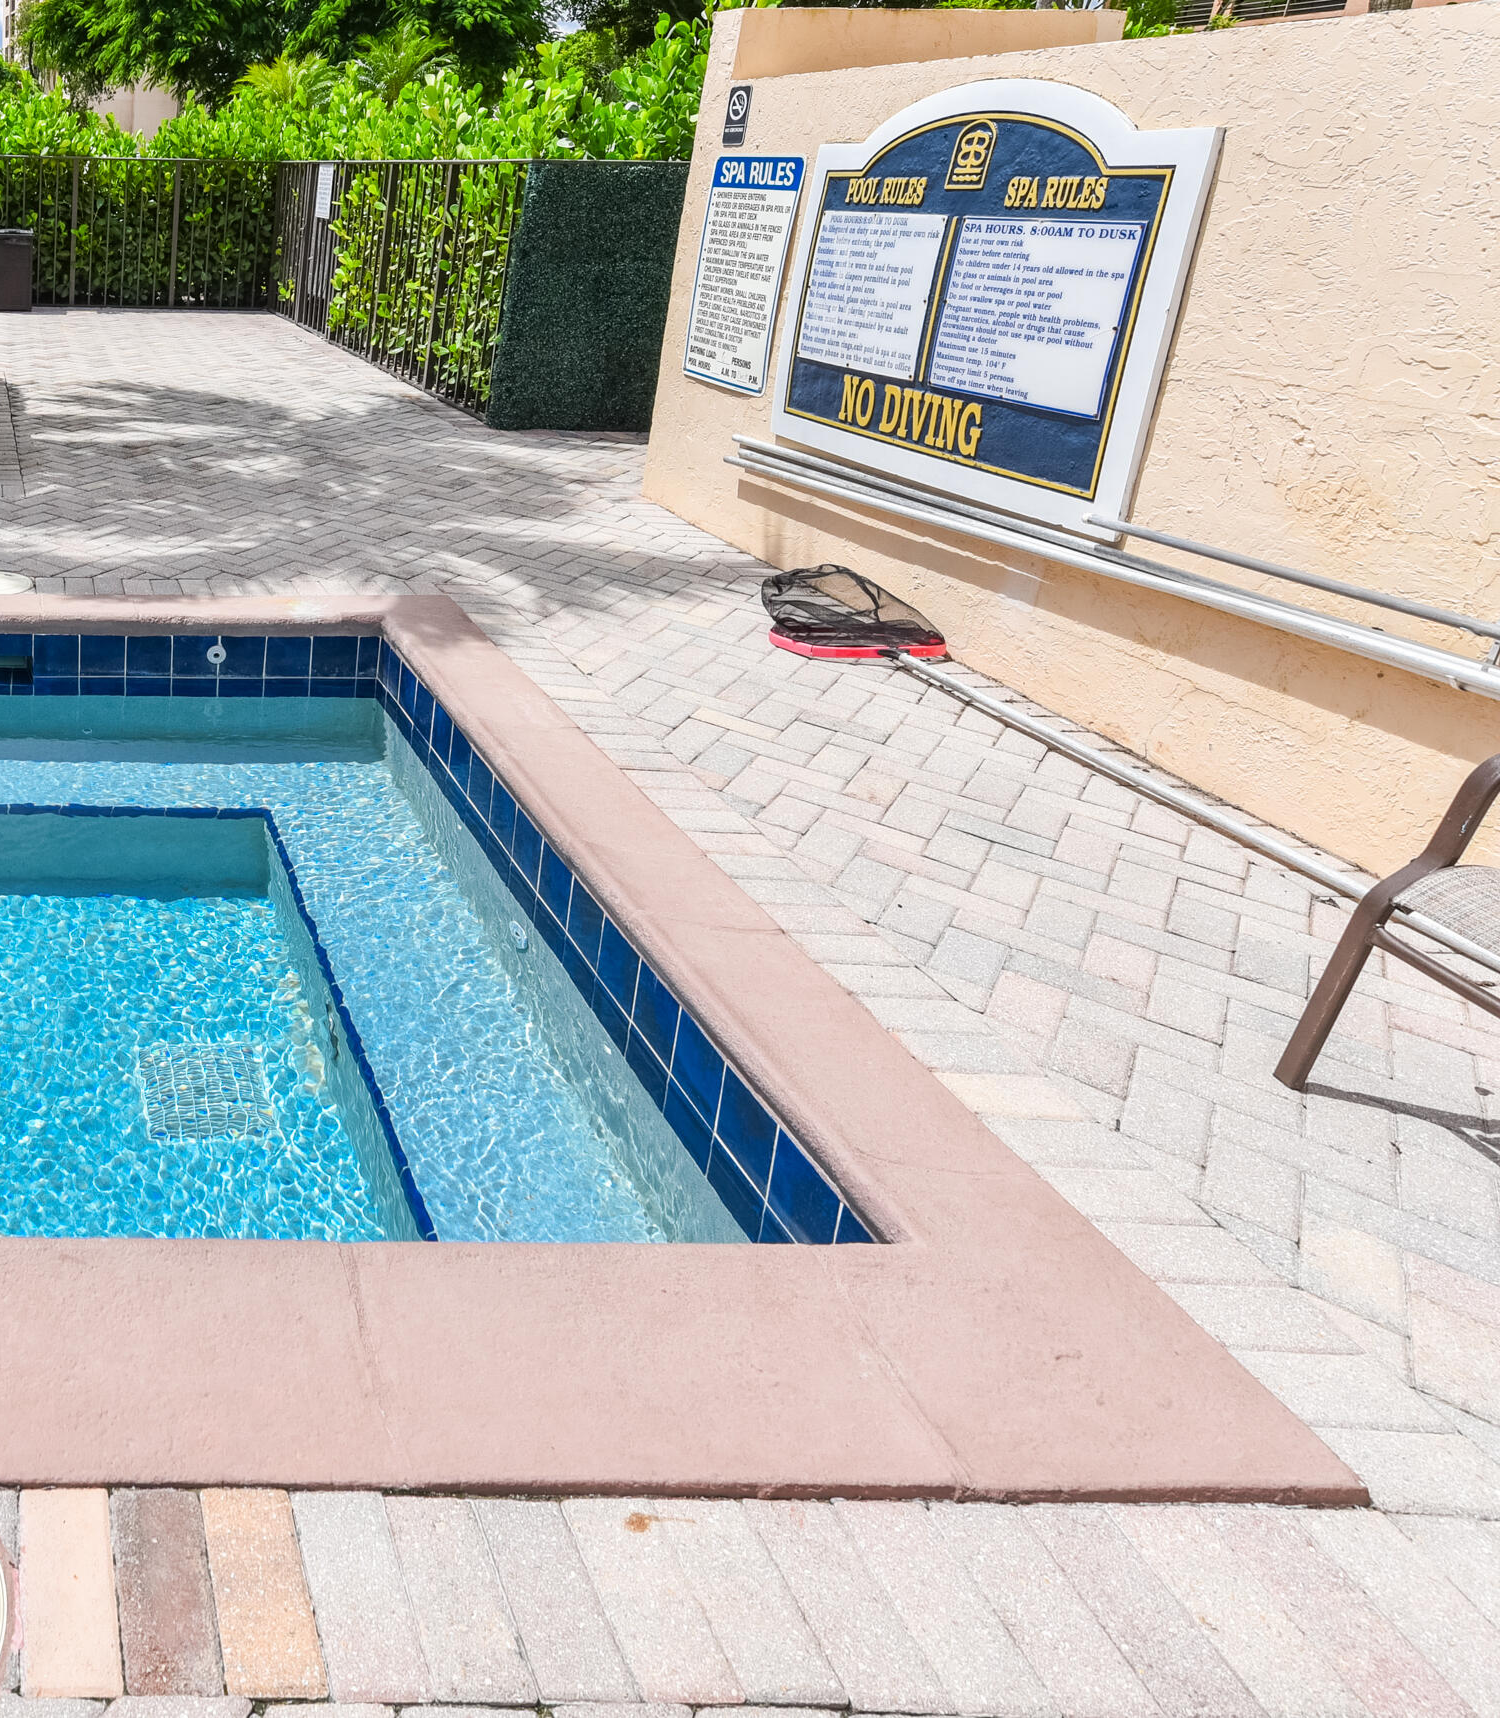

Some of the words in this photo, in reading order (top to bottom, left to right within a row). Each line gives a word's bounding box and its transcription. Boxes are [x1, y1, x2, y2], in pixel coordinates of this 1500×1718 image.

[720, 162, 745, 184] SPA
[749, 162, 795, 186] RULES
[845, 177, 881, 205] POOL
[879, 177, 928, 205] RULES
[1004, 176, 1040, 208] SPA
[1040, 176, 1109, 209] RULES
[964, 223, 982, 233] SPA
[1030, 225, 1074, 238] 8:00AM
[1077, 228, 1096, 238] TO
[1098, 228, 1139, 240] DUSK
[1010, 239, 1024, 247] risk
[958, 248, 981, 256] Shower
[982, 249, 1002, 258] before
[1002, 252, 1030, 261] entering
[962, 271, 978, 280] glass
[986, 273, 1012, 282] animals
[1013, 275, 1020, 283] in
[965, 260, 990, 269] children
[992, 262, 1011, 270] under
[1042, 266, 1054, 274] old
[1055, 266, 1084, 276] allowed
[1085, 268, 1094, 277] in
[1096, 269, 1109, 278] the
[1110, 272, 1125, 280] spa
[960, 282, 974, 290] food
[982, 284, 1014, 295] beverages
[1015, 287, 1022, 296] in
[1046, 292, 1063, 300] pool
[948, 292, 957, 302] Do
[969, 296, 993, 304] swallow
[994, 299, 1006, 307] spa
[1015, 300, 1032, 309] pool
[1032, 303, 1052, 311] water
[946, 303, 972, 313] Pregnant
[998, 311, 1020, 320] people
[1022, 313, 1037, 322] with
[1038, 314, 1062, 325] health
[942, 321, 974, 332] drowsiness
[975, 326, 997, 336] should
[1036, 333, 1045, 343] or
[1064, 338, 1093, 349] without
[944, 312, 960, 322] using
[992, 318, 1016, 329] alcohol
[1026, 323, 1046, 333] drugs
[1047, 325, 1064, 335] that
[1064, 329, 1085, 338] cause
[940, 331, 971, 342] consulting
[977, 335, 998, 345] doctor
[936, 351, 964, 363] Maximum
[938, 340, 967, 352] Maximum
[981, 347, 989, 355] 15
[990, 350, 1016, 360] minutes
[934, 362, 966, 376] Occupancy
[967, 368, 982, 377] limit
[989, 374, 1015, 384] persons
[932, 372, 946, 382] Turn
[968, 380, 985, 389] timer
[987, 384, 1004, 393] when
[1004, 387, 1029, 400] leaving
[838, 373, 875, 427] NO
[878, 384, 982, 456] DIVING
